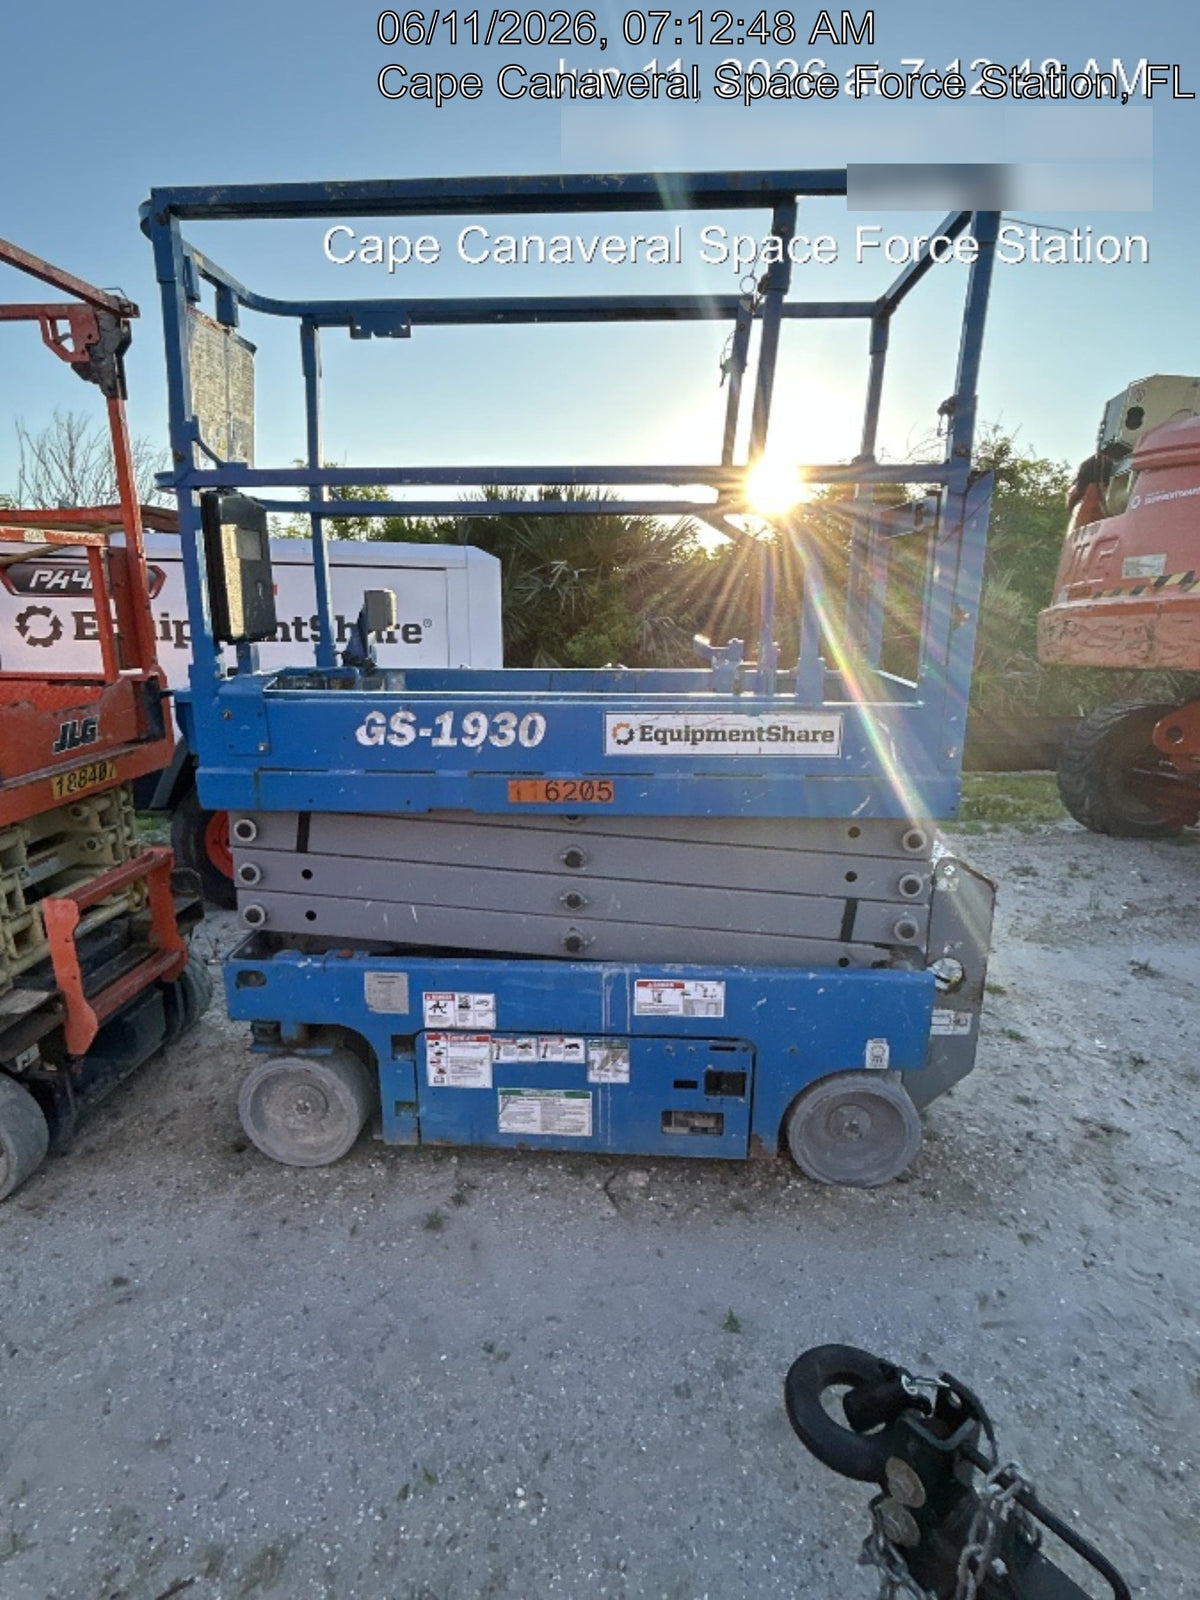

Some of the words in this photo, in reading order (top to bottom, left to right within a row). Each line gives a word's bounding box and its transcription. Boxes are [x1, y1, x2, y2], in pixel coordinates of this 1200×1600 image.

[53, 715, 100, 754] JLG
[355, 711, 547, 748] GS-1930
[639, 724, 834, 747] EquipmentShare
